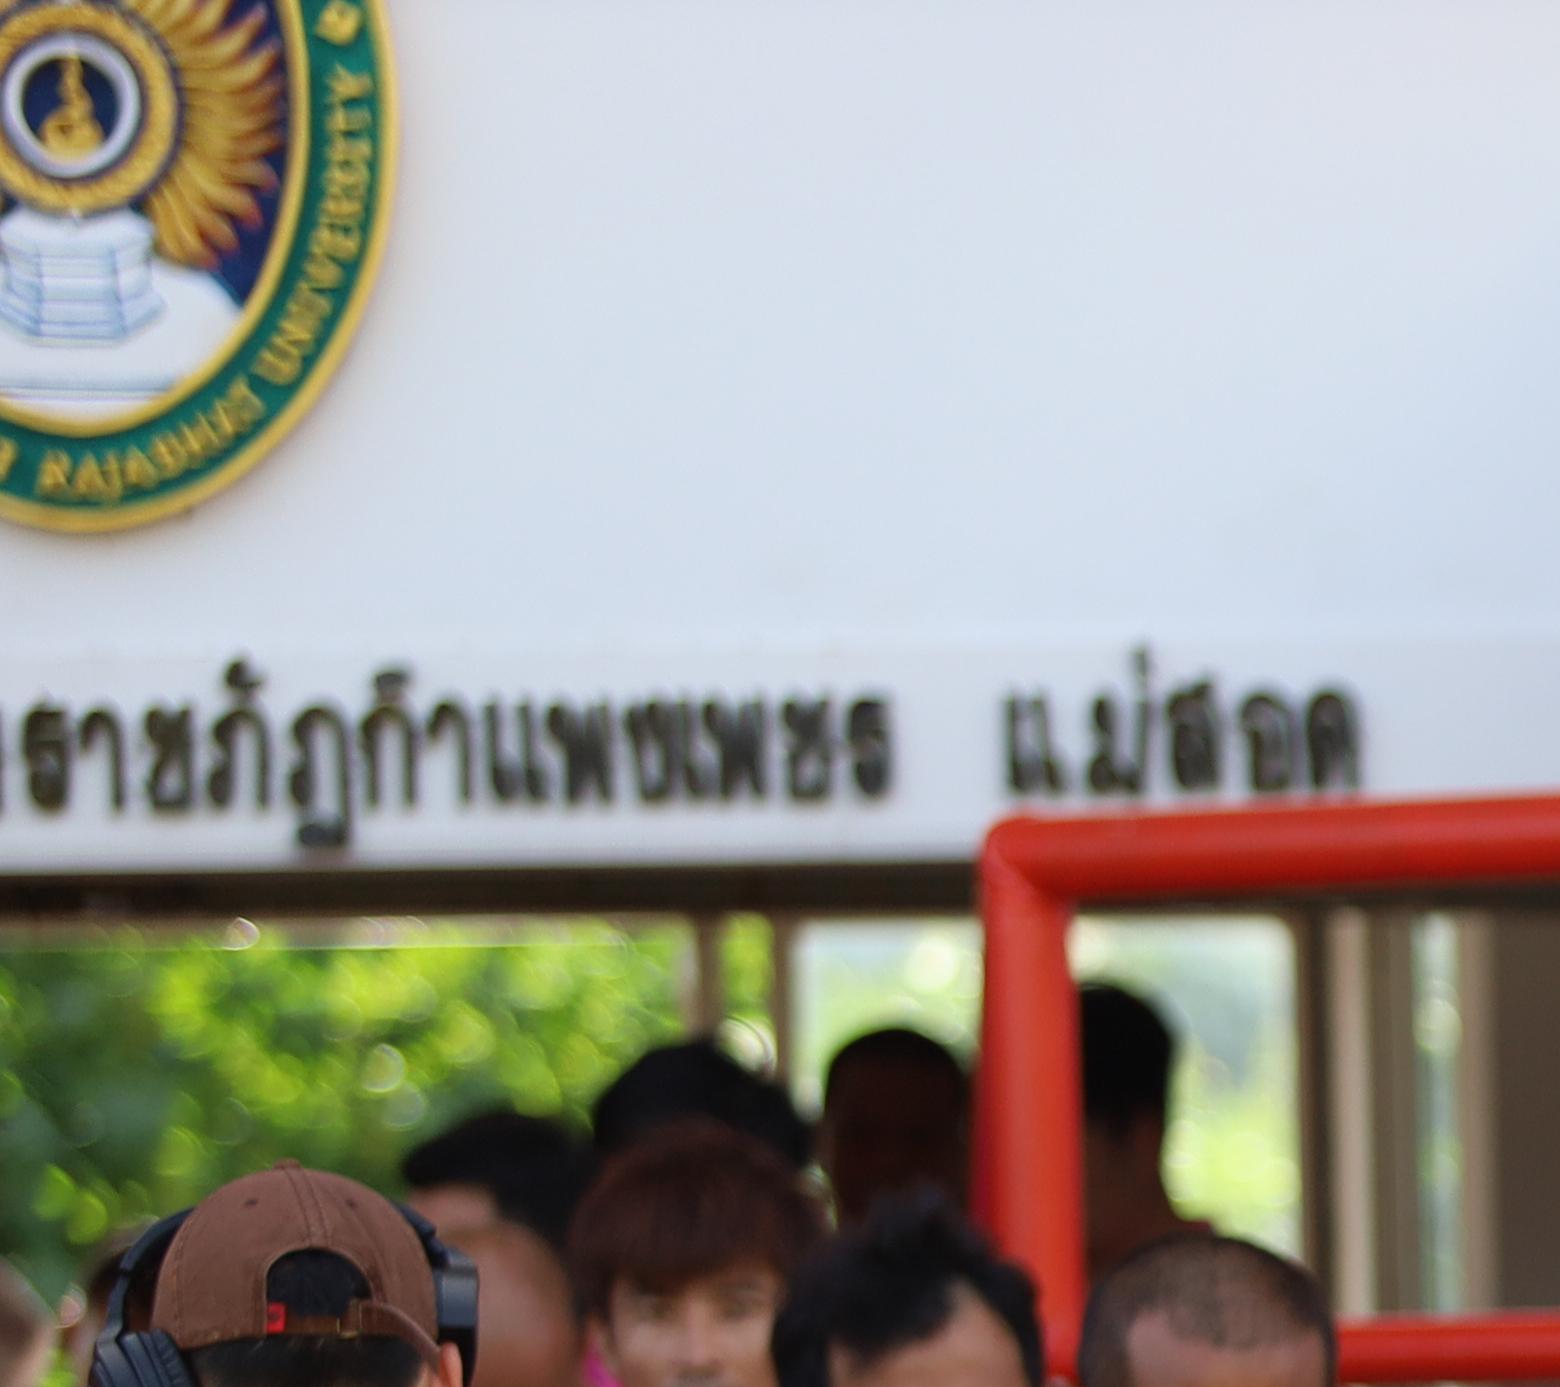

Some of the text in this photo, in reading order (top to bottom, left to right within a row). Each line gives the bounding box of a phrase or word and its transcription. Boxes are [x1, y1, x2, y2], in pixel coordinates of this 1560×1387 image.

[0, 655, 893, 848] ราชภัฏกำแพงเพชร
